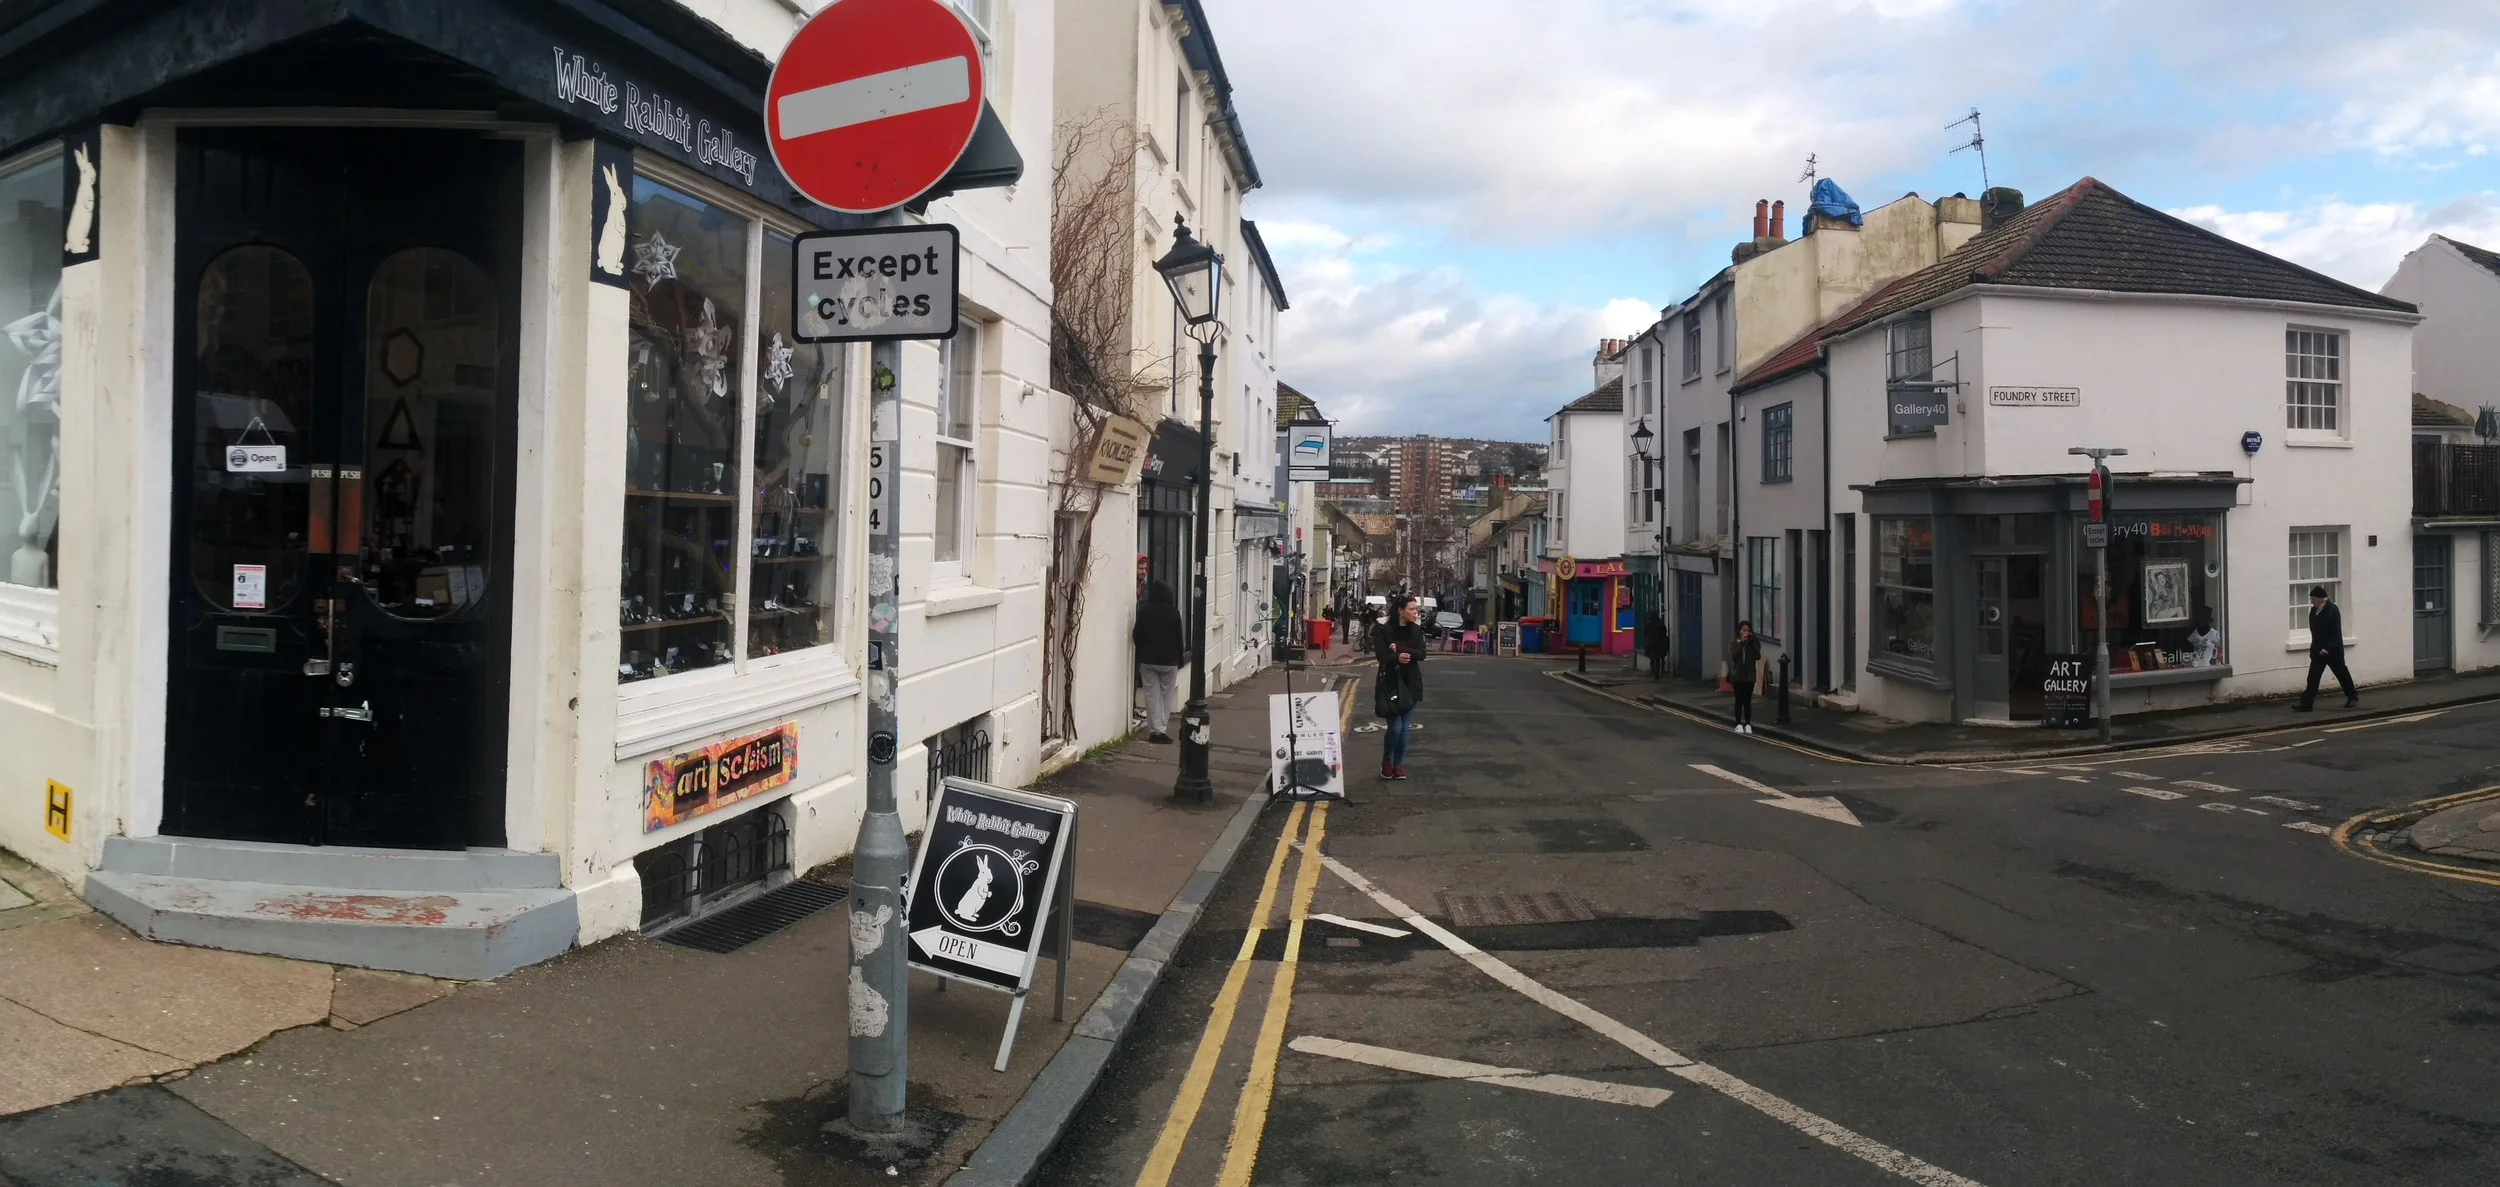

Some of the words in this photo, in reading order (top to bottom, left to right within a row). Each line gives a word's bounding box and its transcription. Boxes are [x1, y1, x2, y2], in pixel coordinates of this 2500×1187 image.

[553, 46, 618, 115] White
[624, 81, 693, 153] Rabbit
[697, 119, 757, 186] Gallery
[813, 245, 939, 282] Except
[817, 287, 931, 326] cycles
[1993, 391, 2037, 402] FOUNDRY
[2042, 391, 2076, 402] STREET
[1894, 403, 1946, 417] Gallery40
[250, 453, 277, 463] Open
[311, 469, 332, 479] PUSH
[340, 470, 361, 480] PUSH
[2087, 527, 2106, 535] Except
[2088, 535, 2105, 544] cycles
[2049, 660, 2082, 677] ART
[2043, 679, 2088, 693] GALLERY
[676, 759, 708, 797] art
[49, 784, 69, 835] H
[946, 804, 977, 827] White
[975, 812, 1012, 836] Rabbit
[1010, 820, 1050, 844] Gallery
[938, 935, 978, 960] OPEN
